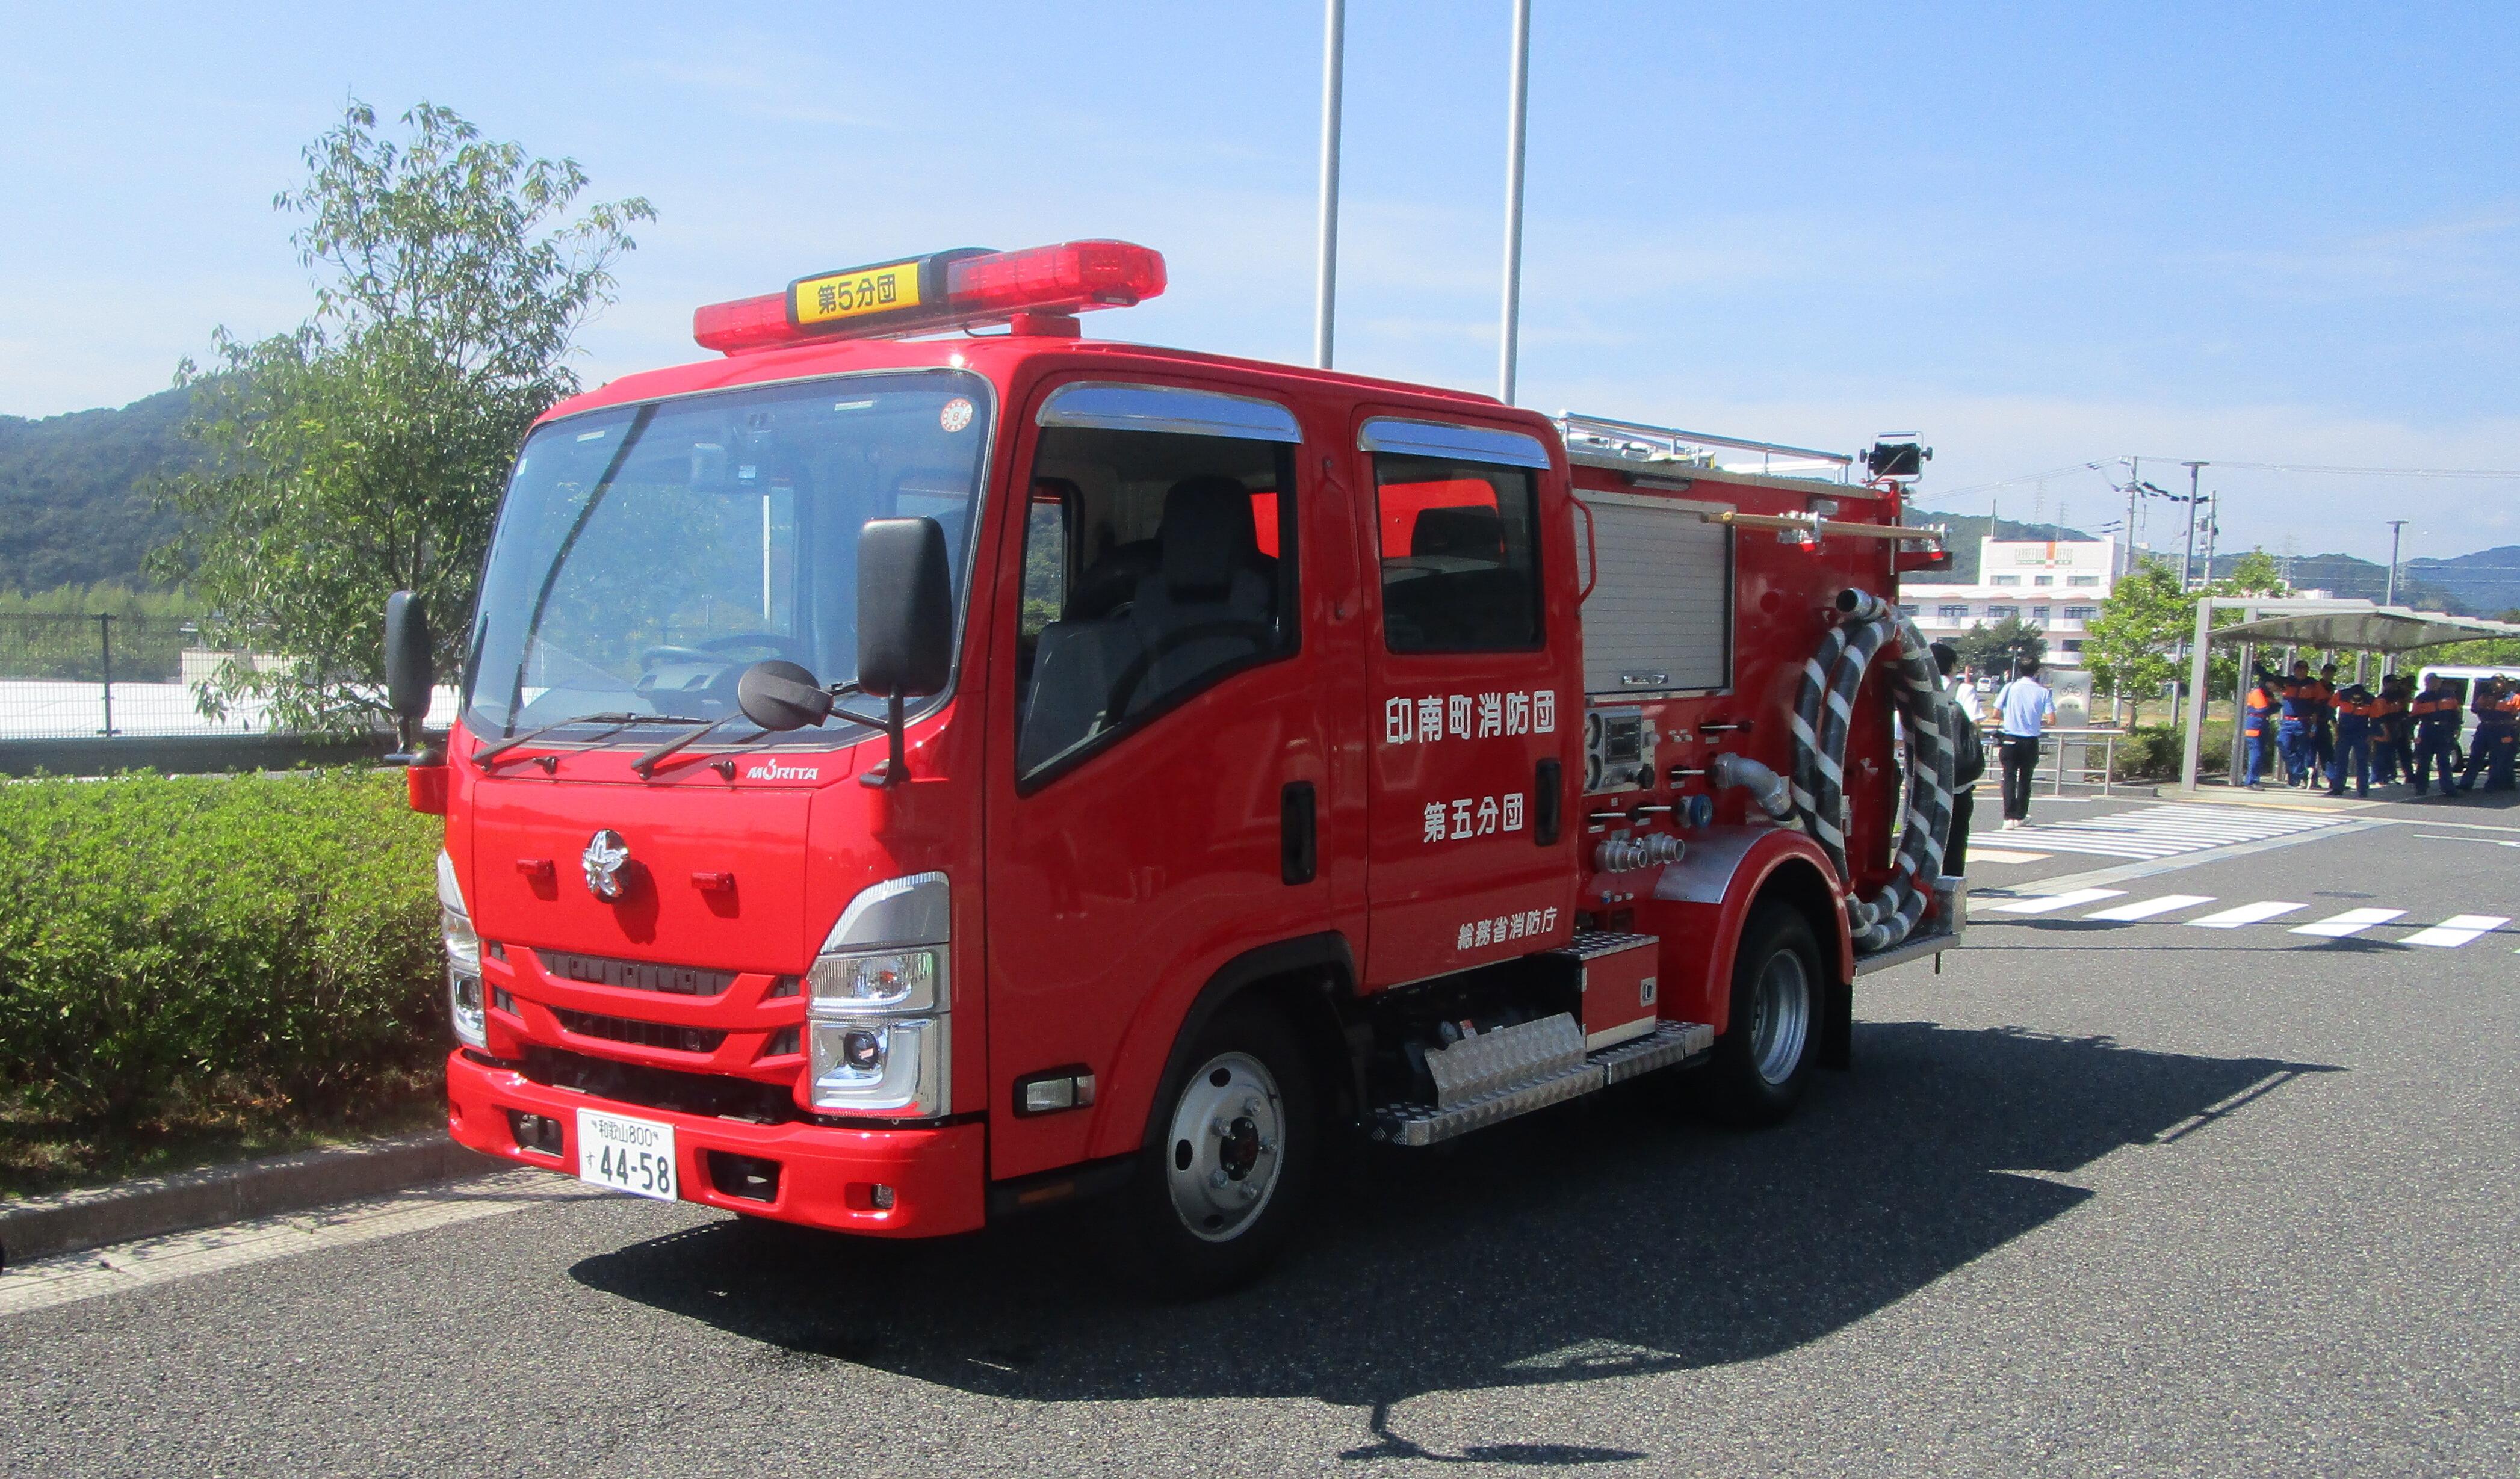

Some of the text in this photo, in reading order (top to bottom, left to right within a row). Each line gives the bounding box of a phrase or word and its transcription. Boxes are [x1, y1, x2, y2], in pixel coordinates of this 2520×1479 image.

[817, 273, 897, 315] 第5分団
[1385, 690, 1555, 744] 印南町消防団
[746, 758, 819, 780] MORITA
[1423, 792, 1523, 843] 第五分団
[1457, 906, 1558, 951] 総務省消防庁
[600, 1145, 670, 1194] 44-58
